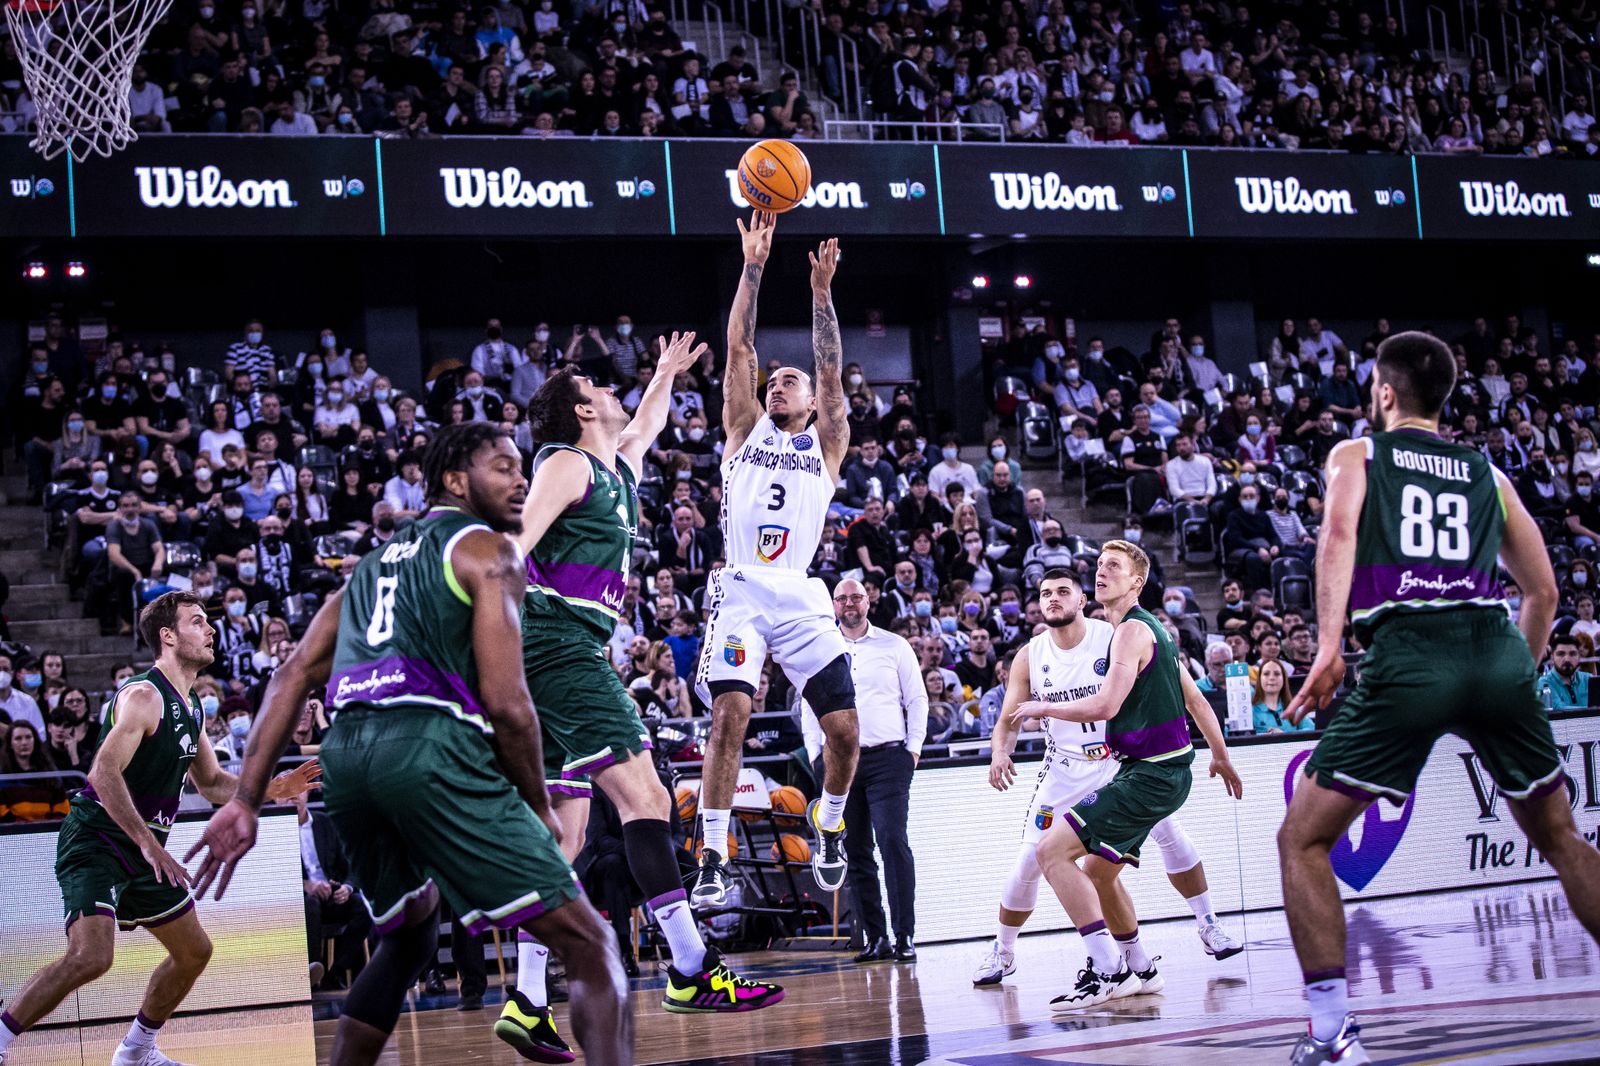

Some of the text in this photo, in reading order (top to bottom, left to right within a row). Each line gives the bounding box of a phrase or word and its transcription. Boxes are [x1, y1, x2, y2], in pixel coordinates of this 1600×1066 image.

[135, 166, 298, 208] Wilson
[440, 167, 594, 208] Wilson
[990, 172, 1123, 211] Wilson
[1235, 177, 1358, 215] Wilson
[1460, 181, 1572, 217] Wilson
[1393, 448, 1471, 483] BOUTEILLE
[767, 483, 786, 511] 3
[762, 534, 782, 546] BT
[1400, 484, 1470, 560] 83
[366, 574, 398, 646] 0
[1465, 831, 1516, 872] The
